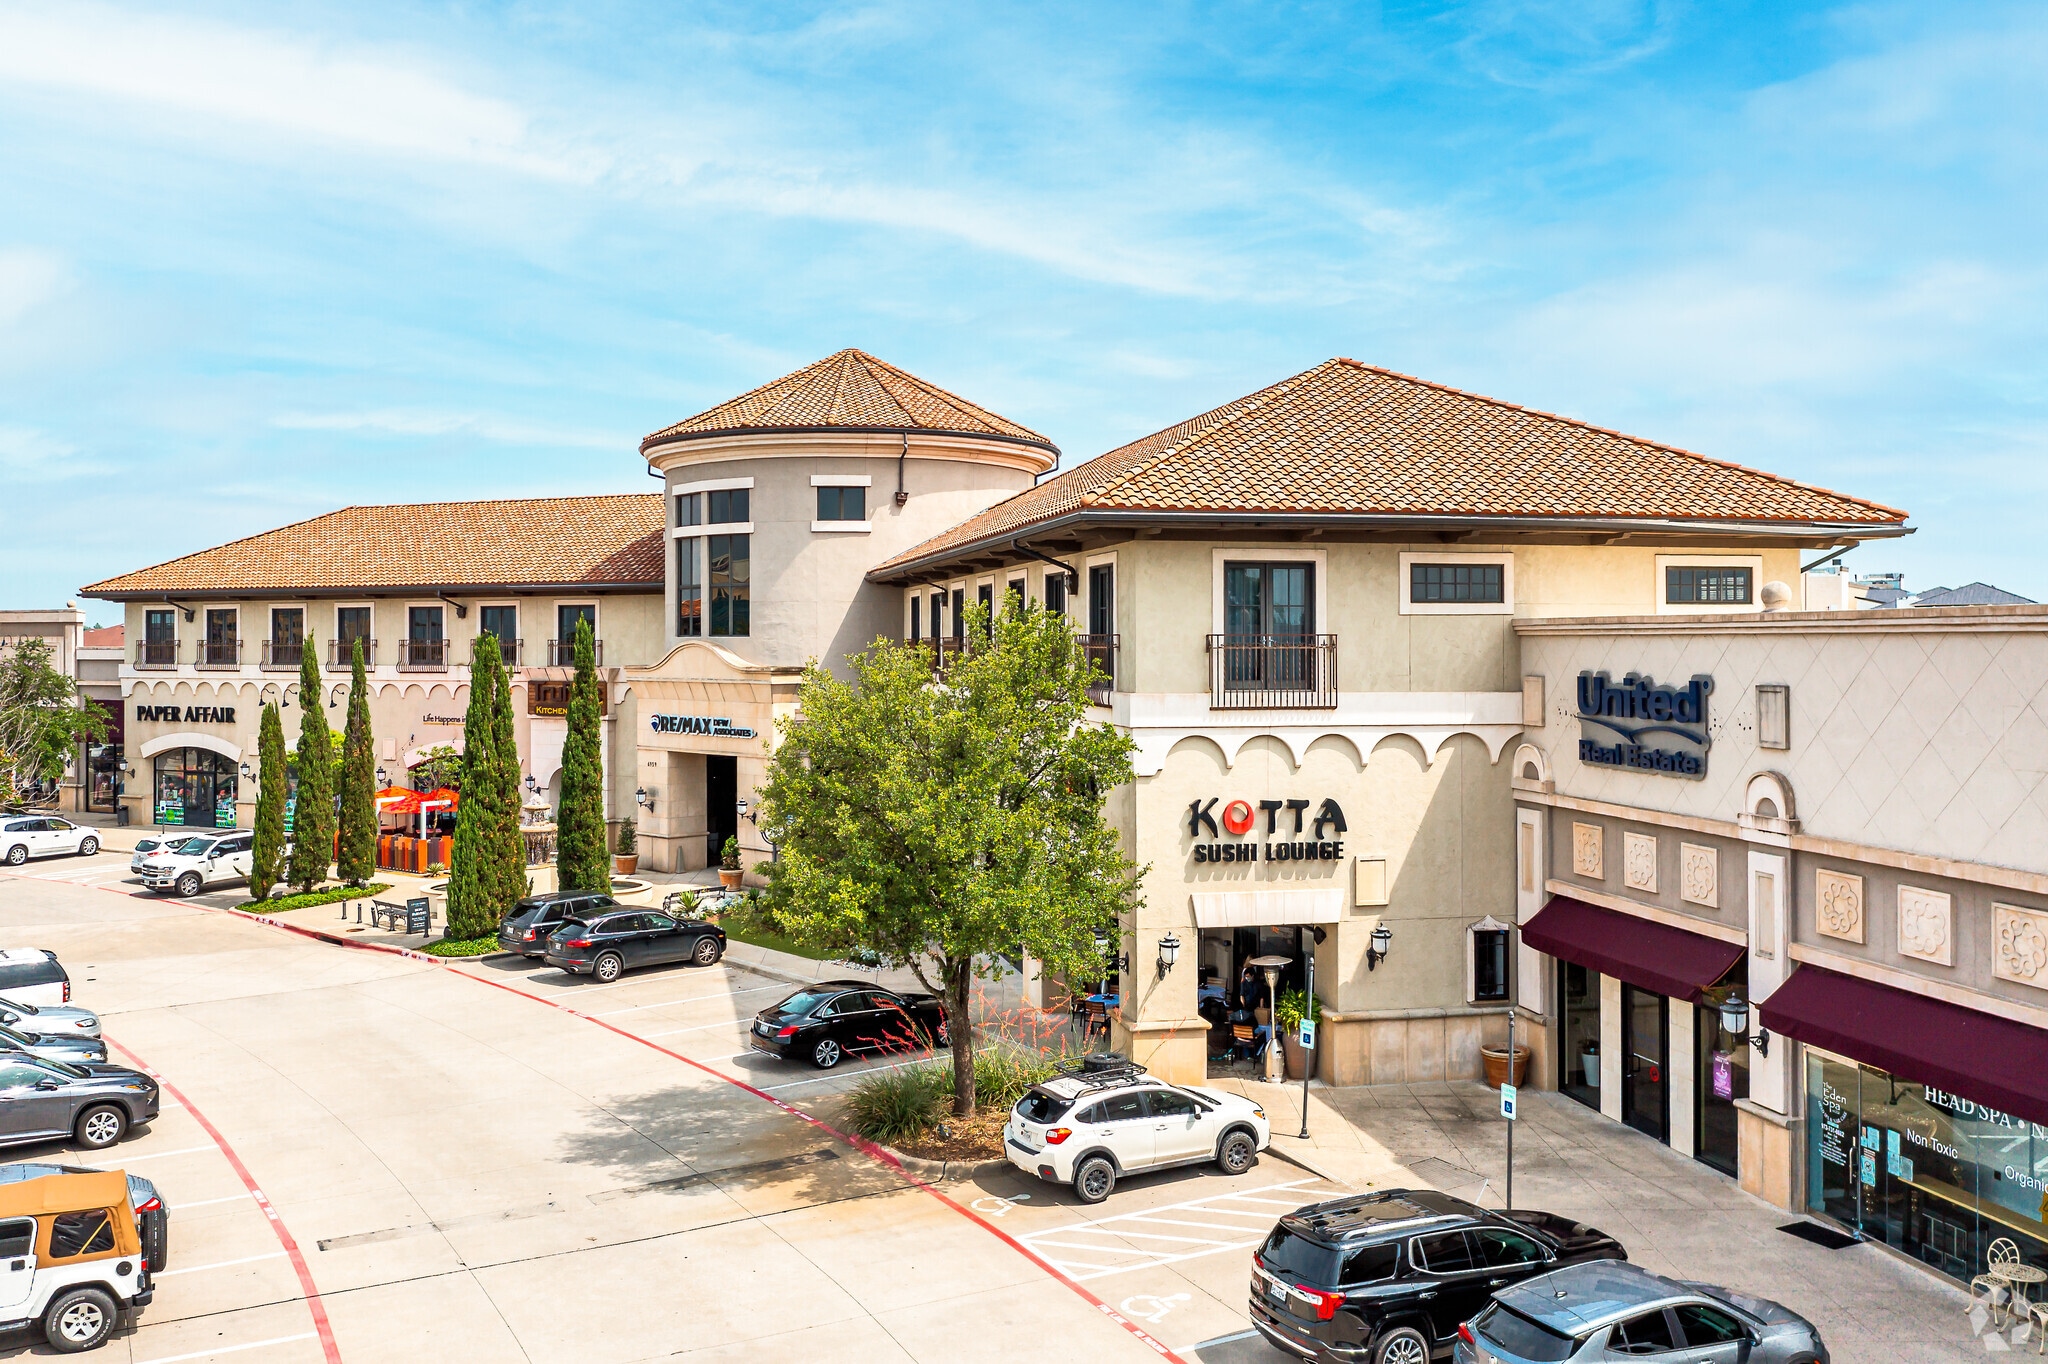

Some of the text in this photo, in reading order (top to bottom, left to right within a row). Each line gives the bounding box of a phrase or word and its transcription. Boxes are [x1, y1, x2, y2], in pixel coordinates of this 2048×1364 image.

[1577, 675, 1699, 723] United
[137, 705, 236, 723] PAPER AFFAIR
[423, 713, 434, 722] Life
[435, 716, 461, 726] Happens
[713, 719, 729, 727] DFW
[660, 715, 712, 735] RE/MAX
[713, 727, 752, 737] ASSOCIATES
[1579, 739, 1700, 775] Real Estate
[1188, 797, 1347, 839] KOTTA
[1194, 841, 1344, 862] SUSHI LOUNGE
[1822, 1096, 1841, 1113] Spa
[1823, 1087, 1847, 1105] Eden
[1924, 1085, 2048, 1141] HEAD SPA N
[1906, 1128, 1928, 1148] Non
[1930, 1137, 1958, 1159] Toxic
